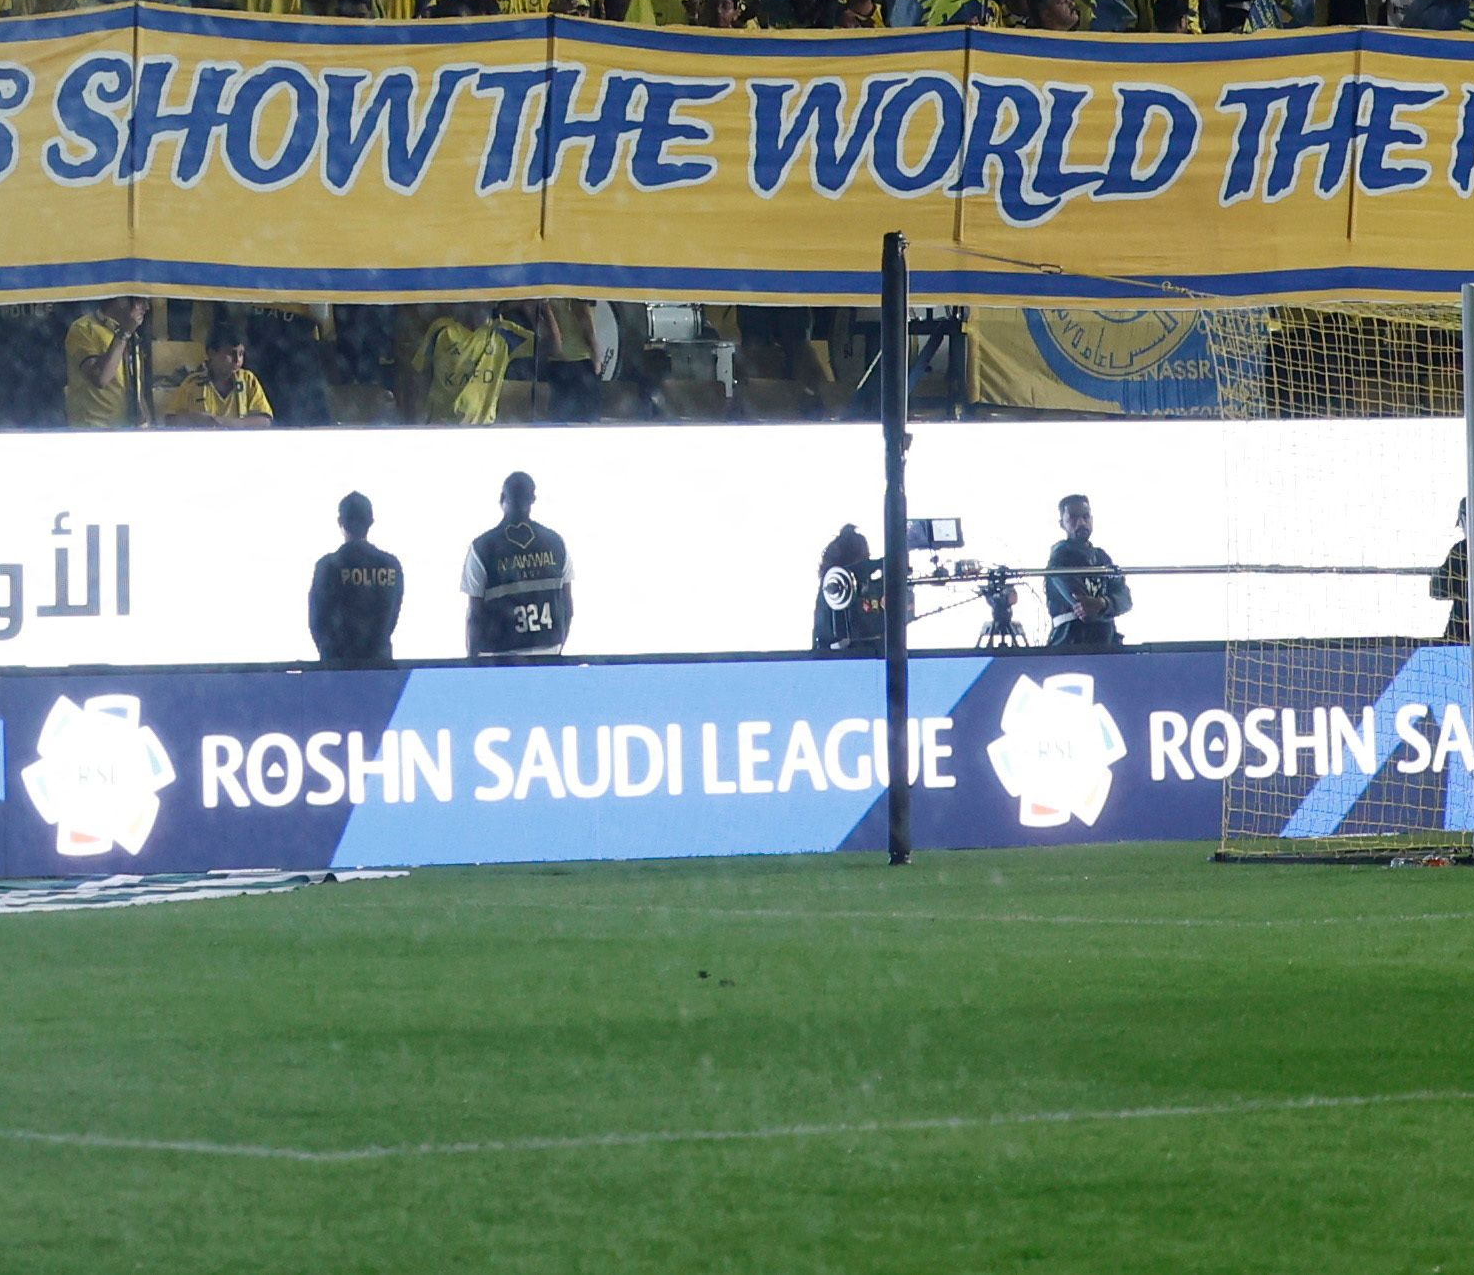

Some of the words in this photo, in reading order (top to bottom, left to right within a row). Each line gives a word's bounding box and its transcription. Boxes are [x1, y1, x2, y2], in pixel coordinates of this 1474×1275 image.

[45, 57, 478, 197] SHOW
[476, 66, 736, 195] THE
[744, 71, 1202, 229] WORLD
[1217, 75, 1446, 206] THE
[341, 568, 396, 587] POLICE
[514, 601, 554, 633] 324
[201, 729, 453, 810] ROSHN
[474, 723, 682, 801] SAUDI
[1150, 705, 1378, 781] ROSHN
